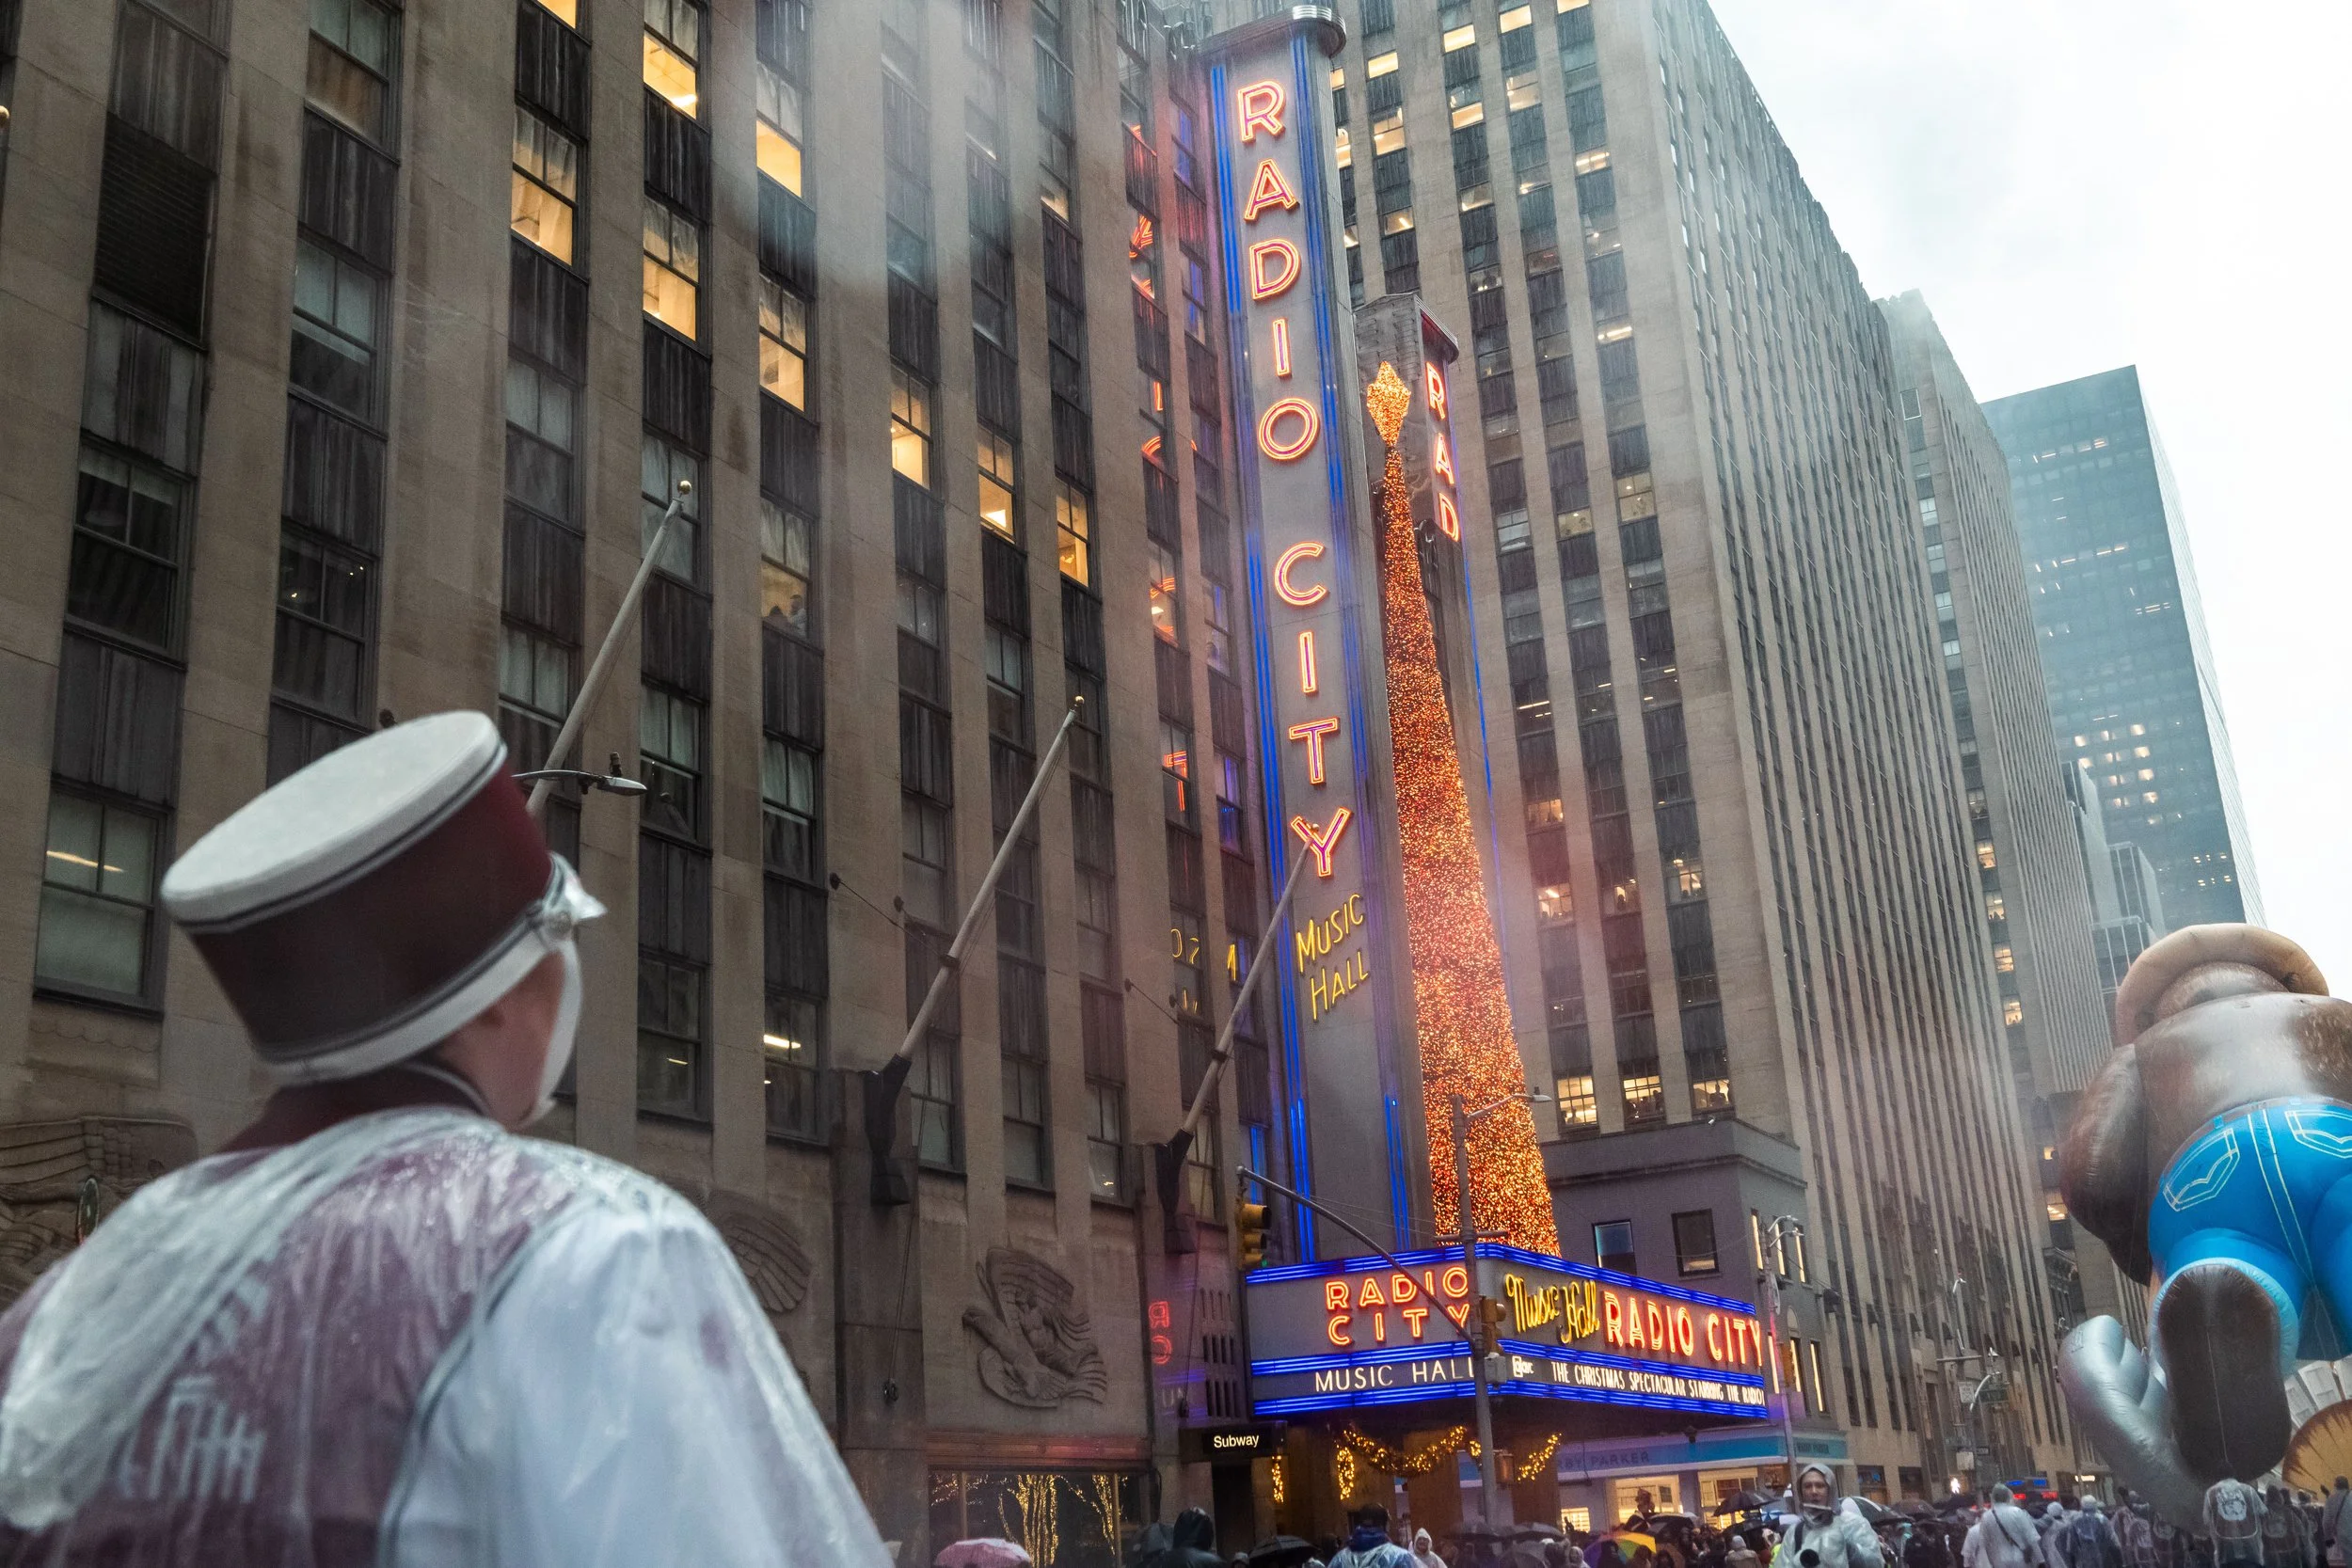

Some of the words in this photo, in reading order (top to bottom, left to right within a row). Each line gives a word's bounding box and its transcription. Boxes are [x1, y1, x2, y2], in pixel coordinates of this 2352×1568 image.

[1236, 80, 1321, 461] RADIO
[1273, 541, 1353, 879] CITY
[1295, 893, 1365, 974] MUSIC
[1309, 950, 1370, 1022] HALL
[1326, 1266, 1469, 1311] RADIO
[1327, 1304, 1470, 1346] CITY
[1505, 1274, 1560, 1333] Music
[1559, 1280, 1601, 1344] Hall
[1603, 1291, 1695, 1357] RADIO
[1707, 1312, 1763, 1367] CITY
[1314, 1365, 1393, 1393] MUSIC
[1550, 1361, 1570, 1384] THE
[1574, 1364, 1626, 1390] CHRISTMAS
[1629, 1371, 1687, 1397] SPECTACULAR
[1689, 1379, 1724, 1402] STARRING
[1213, 1434, 1260, 1449] Subway
[1590, 1451, 1650, 1466] PARKER
